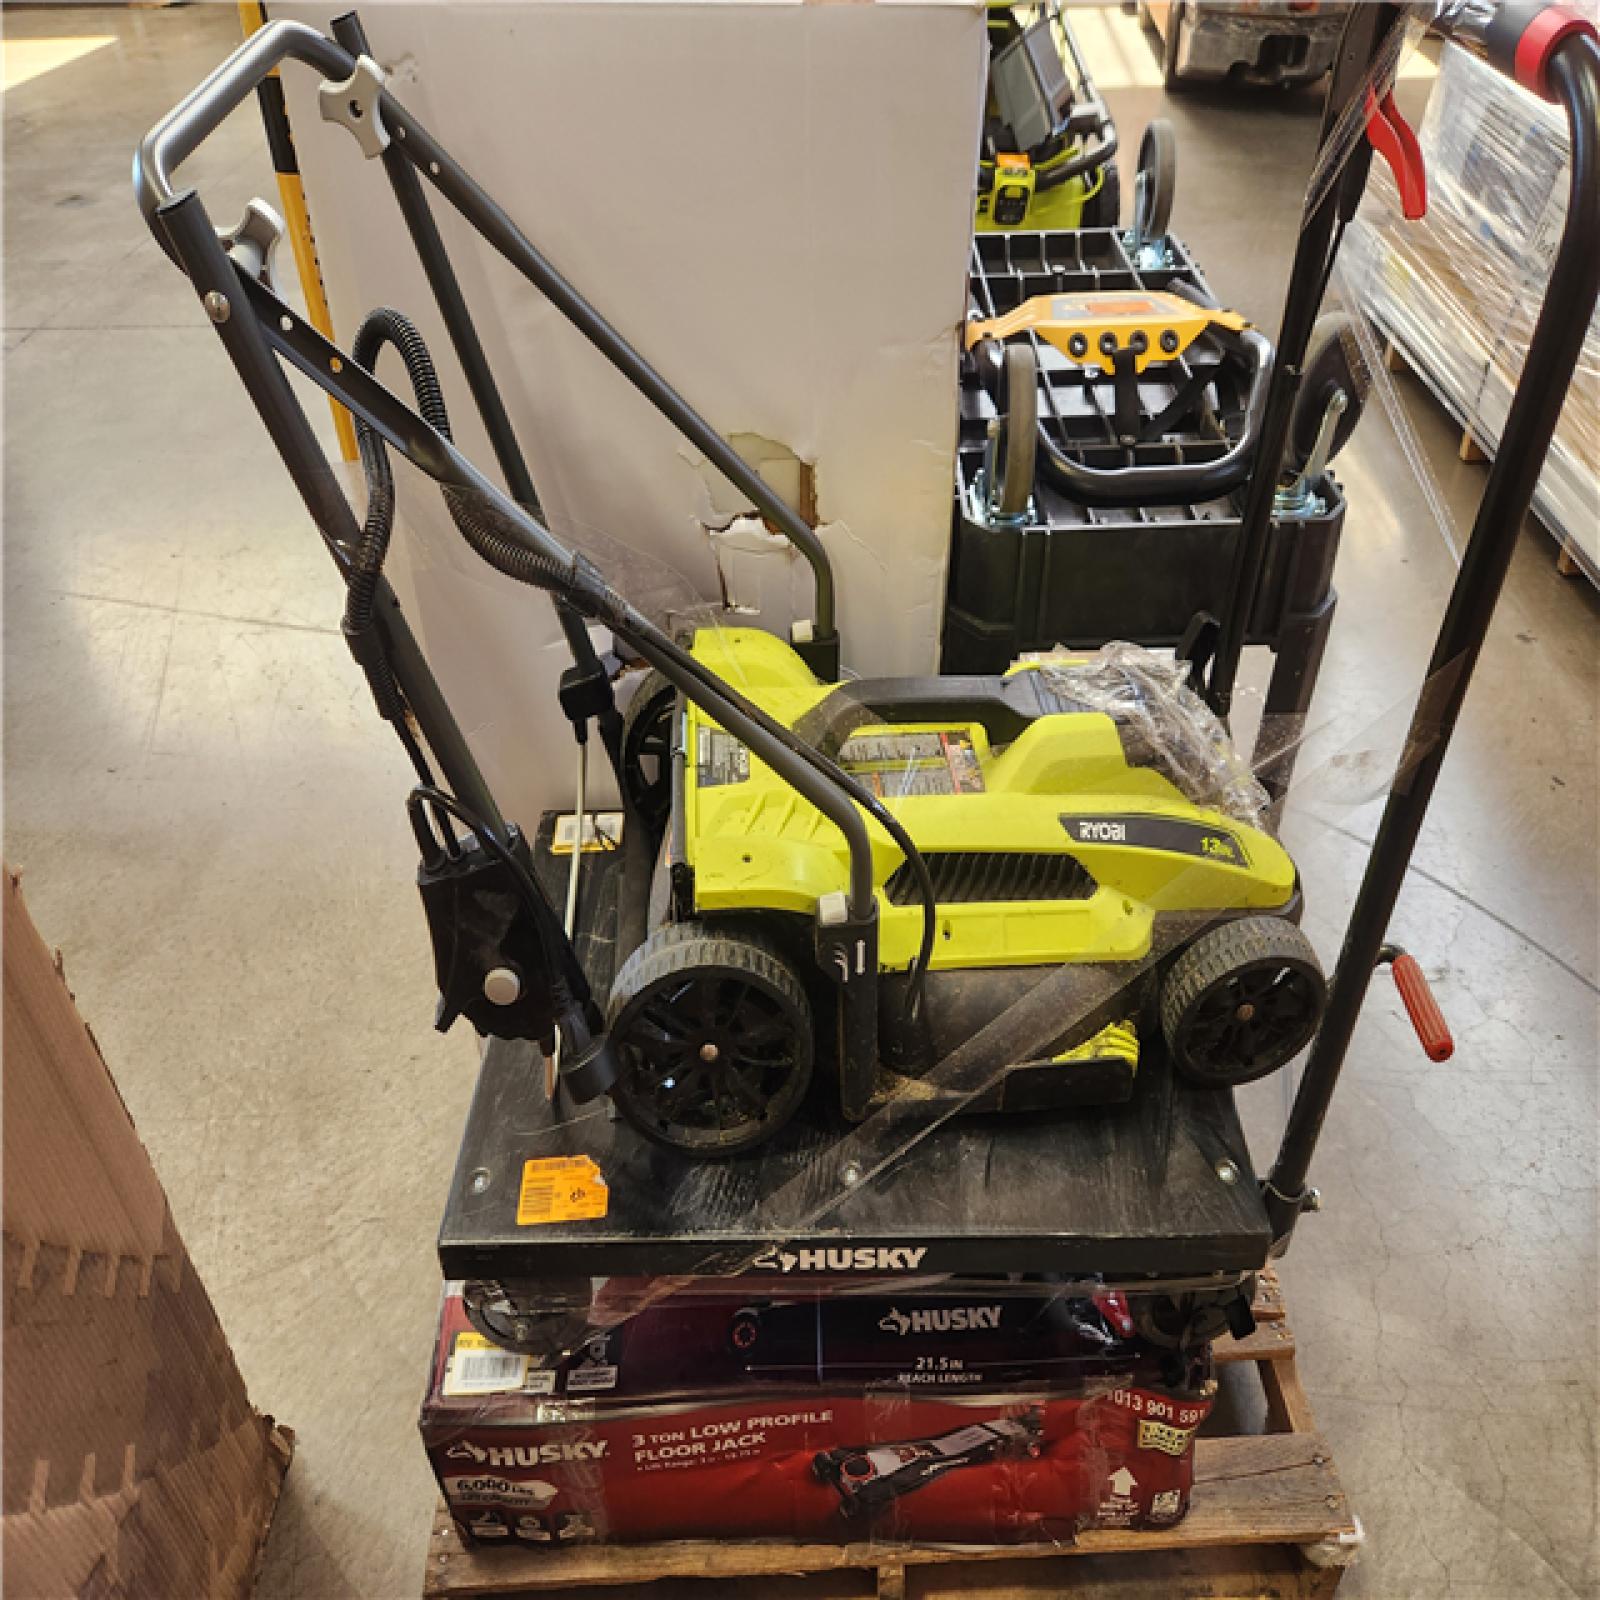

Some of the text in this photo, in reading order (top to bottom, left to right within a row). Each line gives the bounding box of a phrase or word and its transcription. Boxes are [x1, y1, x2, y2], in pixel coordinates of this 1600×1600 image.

[1079, 822, 1126, 841] RYOBI
[799, 1246, 928, 1271] HUSKY
[911, 1304, 1002, 1332] HUSKY
[915, 1356, 949, 1371] 21.5
[632, 1409, 833, 1448] 3 TON LOW PROFILE
[487, 1439, 609, 1467] HUSKY
[634, 1442, 706, 1463] FLOOR
[713, 1431, 766, 1453] JACK
